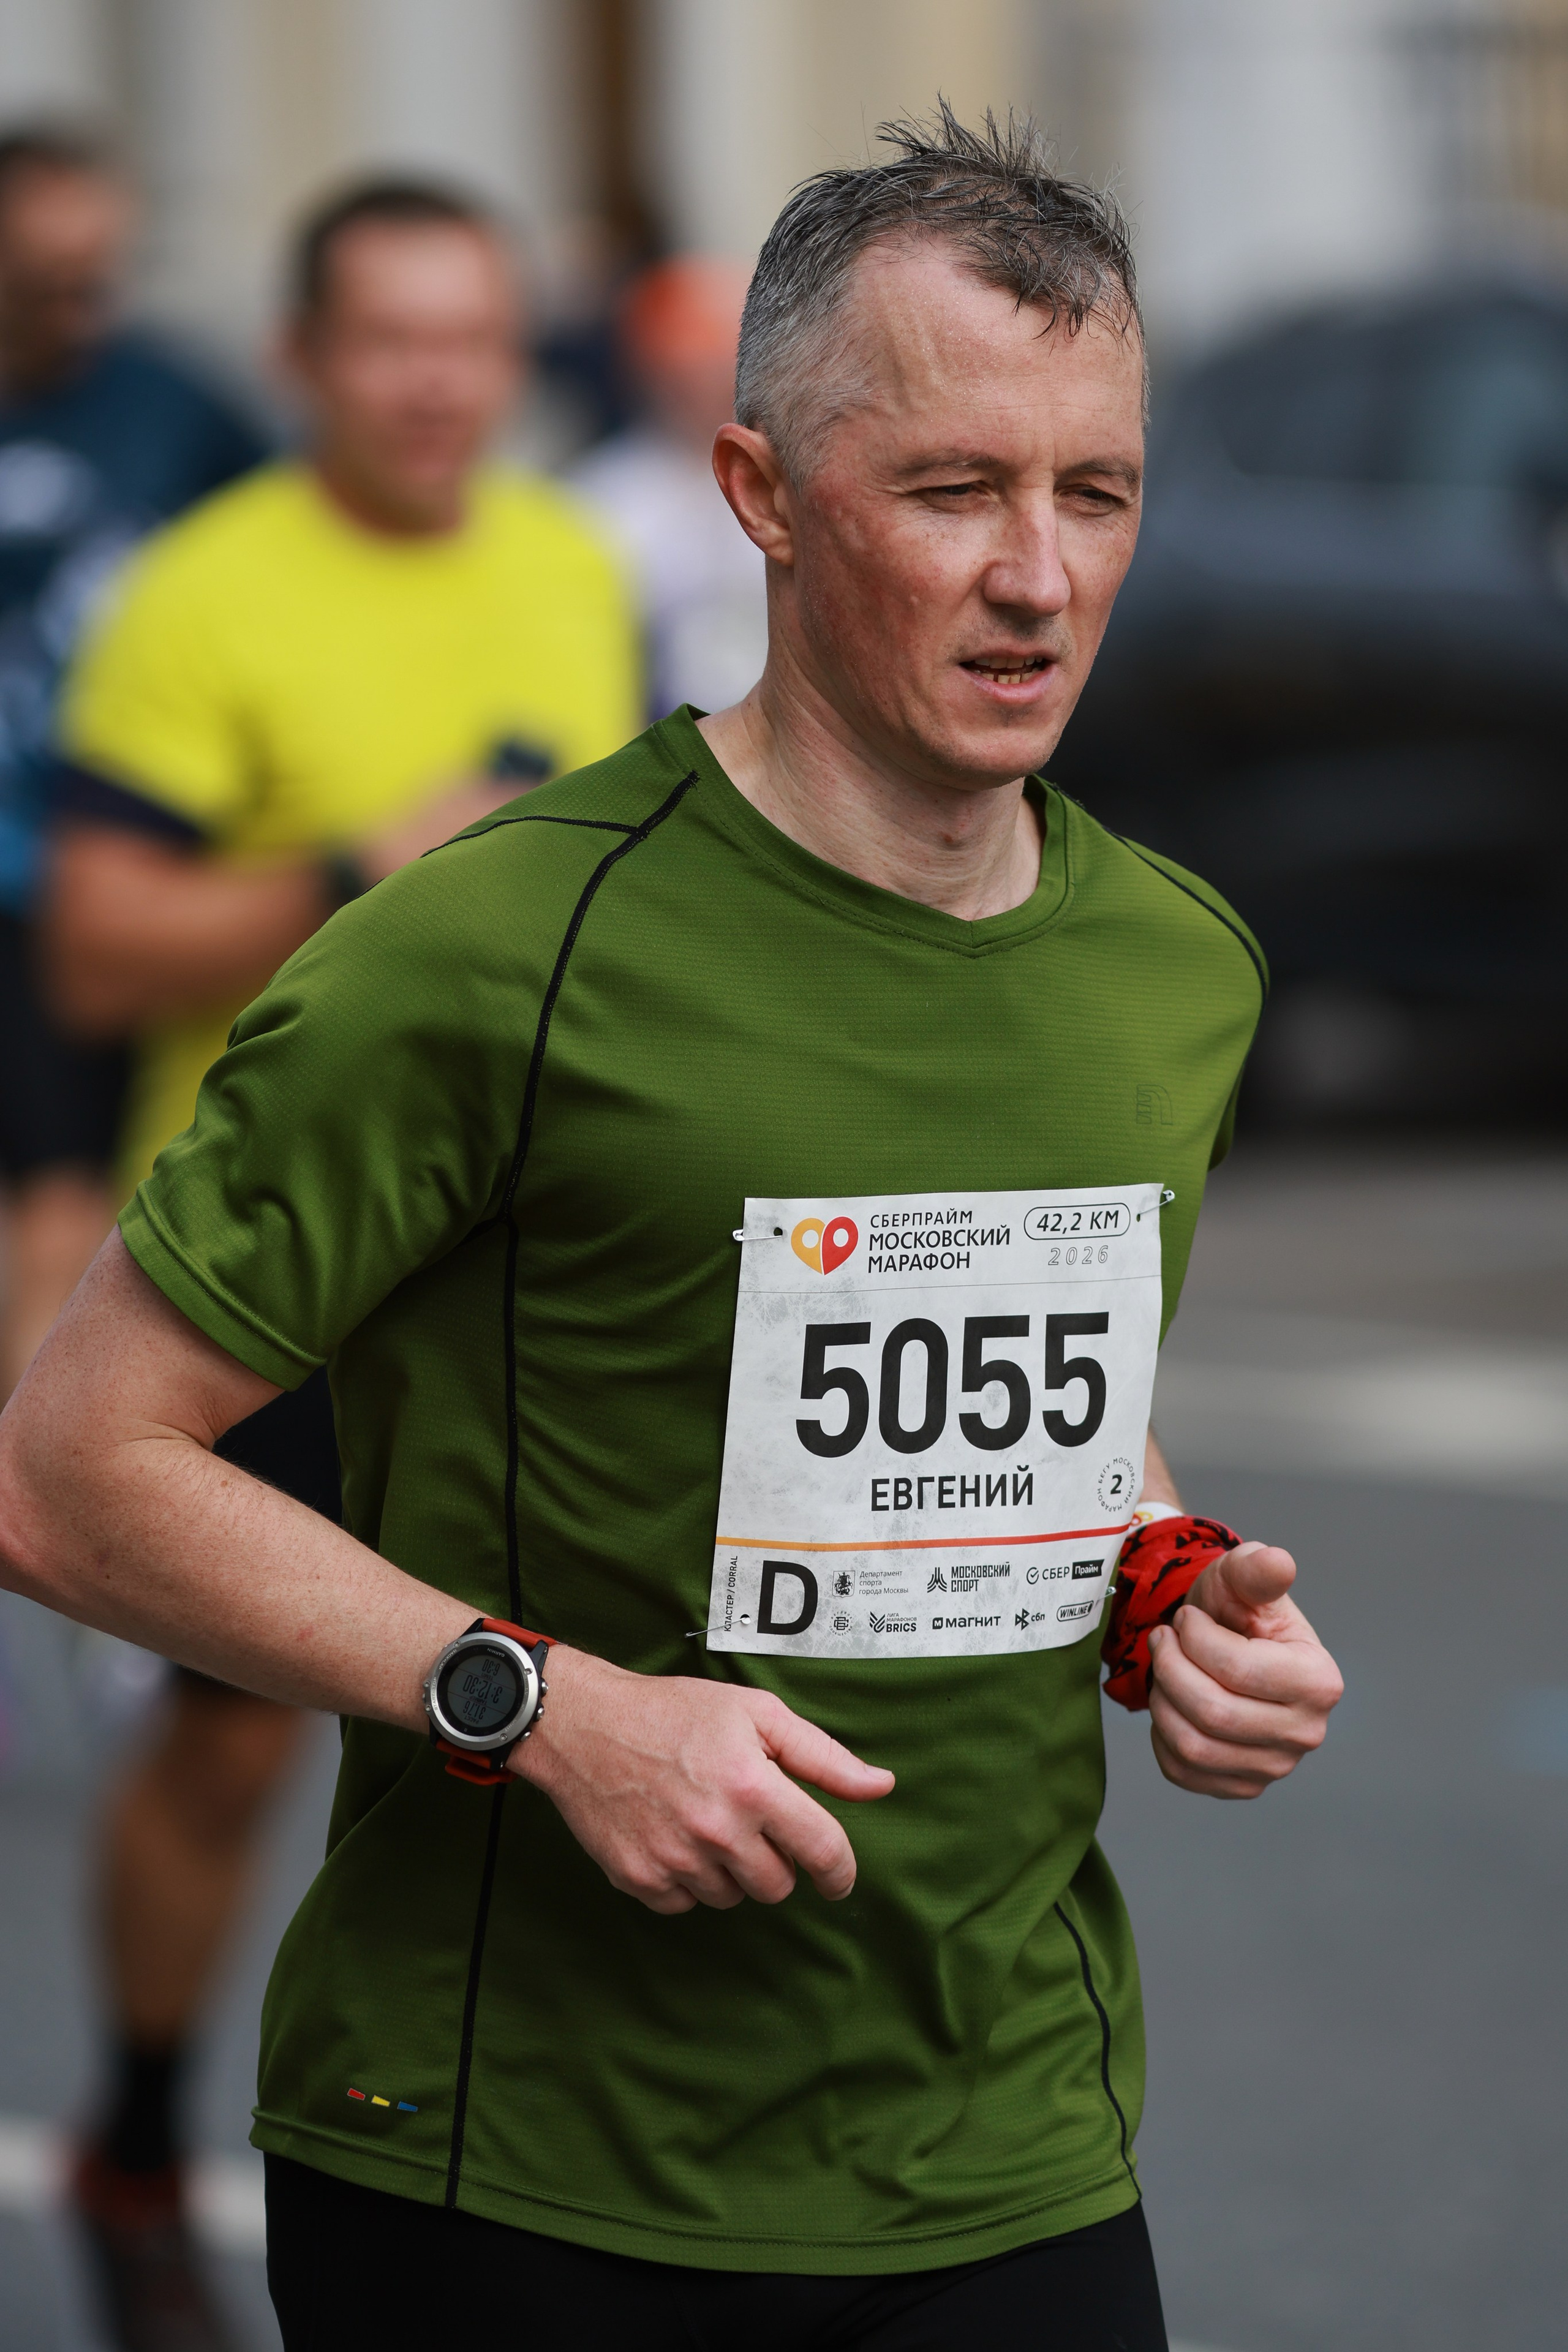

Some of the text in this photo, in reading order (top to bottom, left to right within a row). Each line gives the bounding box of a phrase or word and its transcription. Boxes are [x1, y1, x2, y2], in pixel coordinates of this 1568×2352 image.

[870, 1208, 973, 1228] СБЕРПРАЙМ
[1036, 1210, 1119, 1234] 42,2 КМ
[869, 1224, 1011, 1251] МОСКОВСКИЙ
[868, 1251, 970, 1273] МАРАФОН
[1048, 1245, 1109, 1265] 2026
[796, 1311, 1109, 1458] 5055
[870, 1464, 1033, 1512] ЕВГЕНИЙ
[1097, 1457, 1135, 1512] БЕГУ МОСКОВСКИЙ МАРАФОН
[1110, 1474, 1122, 1494] 2
[728, 1556, 738, 1588] CORRAL
[951, 1562, 1010, 1578] МОСКОВСКИЙ
[1042, 1564, 1098, 1580] СБЕР Прайм
[951, 1579, 979, 1593] СПОРТ
[756, 1560, 818, 1635] D
[1031, 1612, 1045, 1622] сбп
[1060, 1605, 1088, 1618] WINLINE
[886, 1623, 916, 1633] BRICS
[946, 1616, 1001, 1628] магнит
[487, 1648, 505, 1657] GARMIN
[482, 1659, 500, 1676] 6:30
[463, 1675, 503, 1703] 3:12:30
[463, 1701, 486, 1720] 31.76
